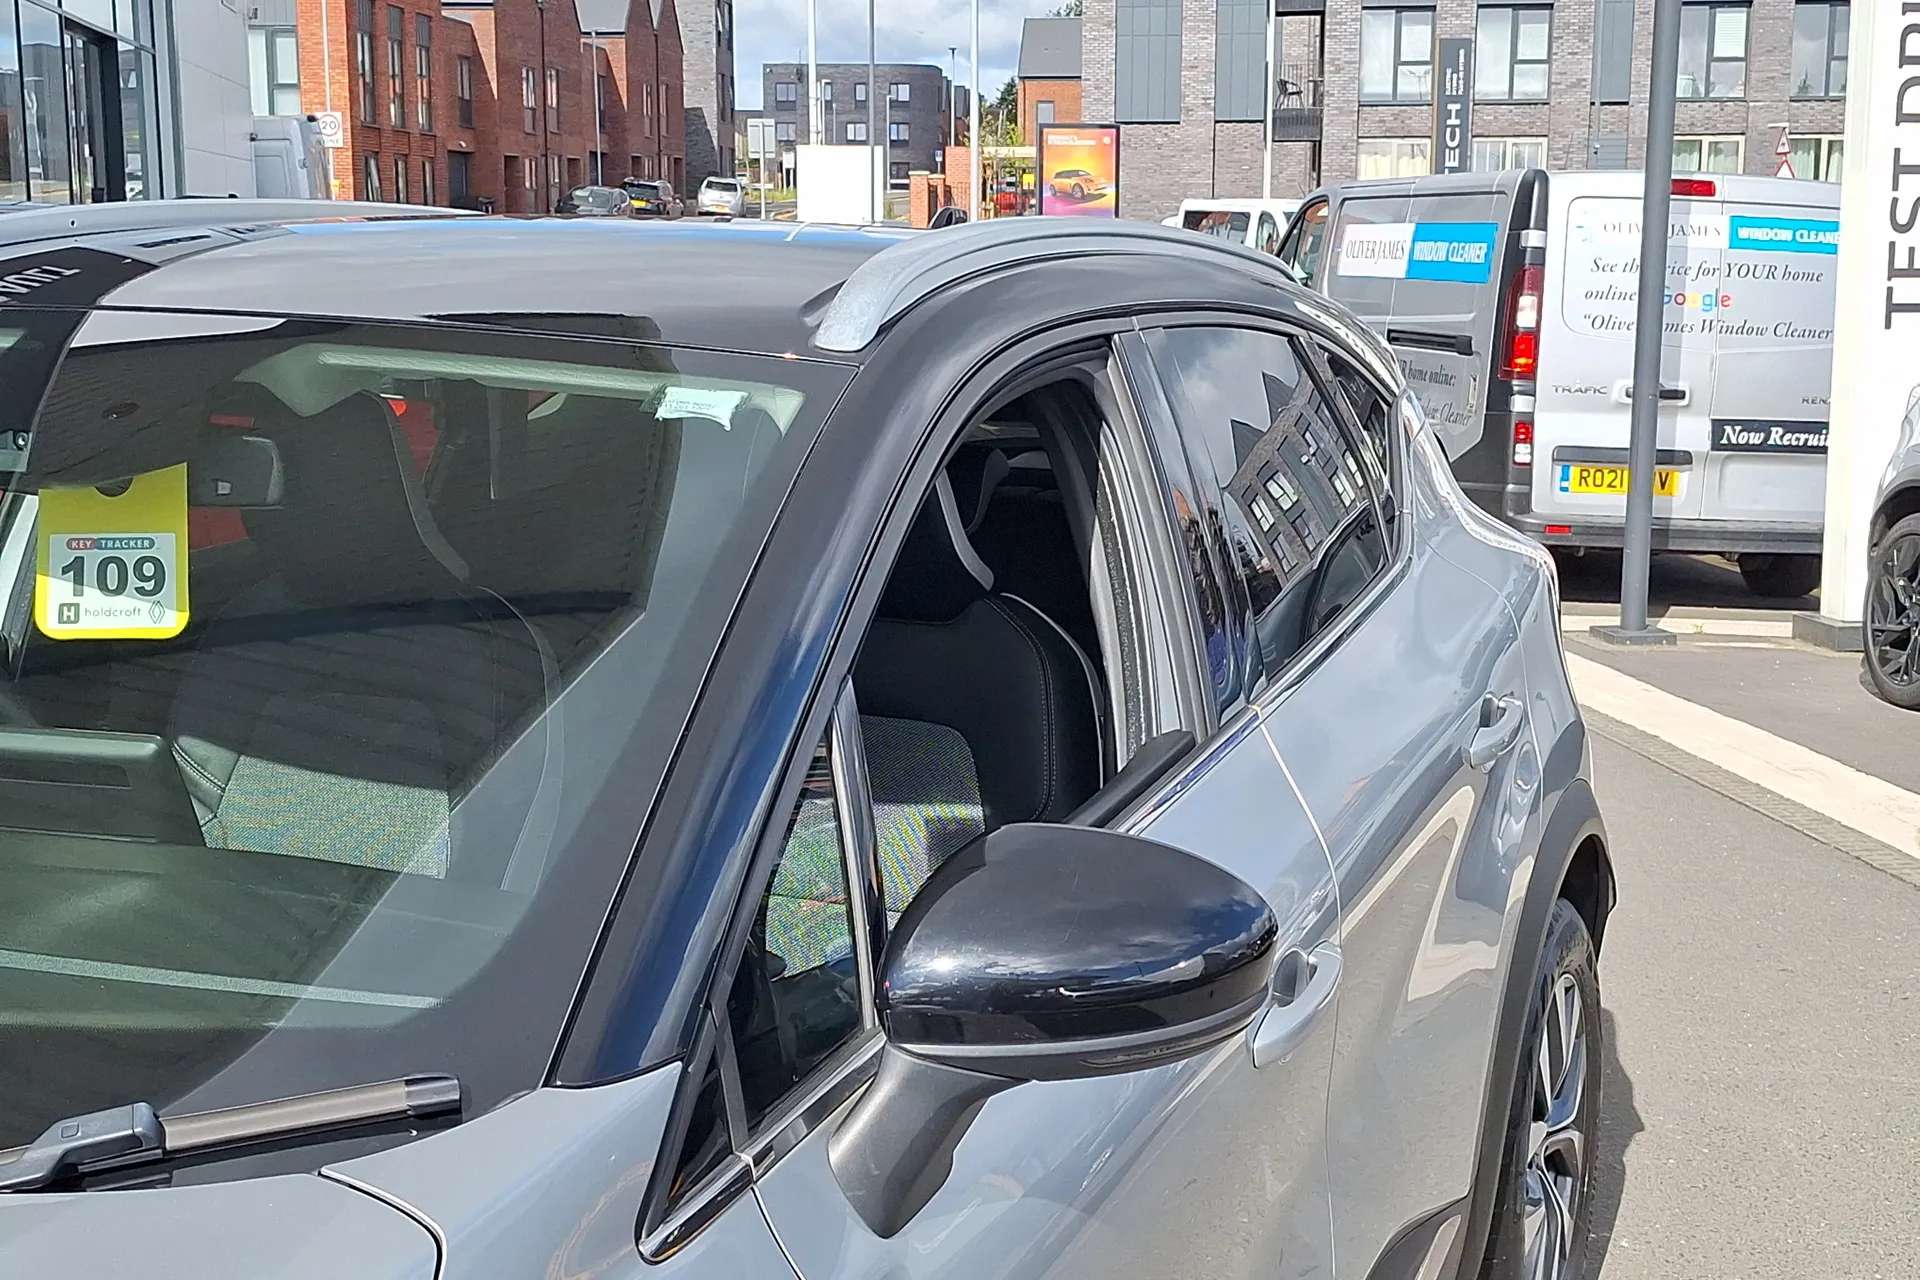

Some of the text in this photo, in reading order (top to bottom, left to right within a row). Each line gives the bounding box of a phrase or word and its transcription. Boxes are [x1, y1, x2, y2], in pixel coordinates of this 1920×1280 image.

[321, 120, 337, 130] 20
[1737, 226, 1839, 245] WINDOW CLEANE
[1885, 147, 1920, 330] TEST
[1346, 240, 1406, 264] OLIVER JAMES
[1413, 240, 1488, 264] WINDOW CLEANER
[1590, 257, 1618, 273] See
[1622, 257, 1641, 273] th
[1691, 260, 1720, 282] for
[1724, 262, 1778, 280] YOUR
[1781, 264, 1824, 282] home
[1584, 284, 1637, 301] online
[1700, 319, 1769, 337] Window
[1552, 385, 1608, 395] TRAFIC
[1440, 402, 1472, 426] Cleaner
[1720, 425, 1829, 447] Now Recrui
[1579, 468, 1625, 489] RO21
[71, 539, 150, 549] KEY TRACKER
[61, 555, 166, 597] 109
[85, 606, 141, 618] holdcroft
